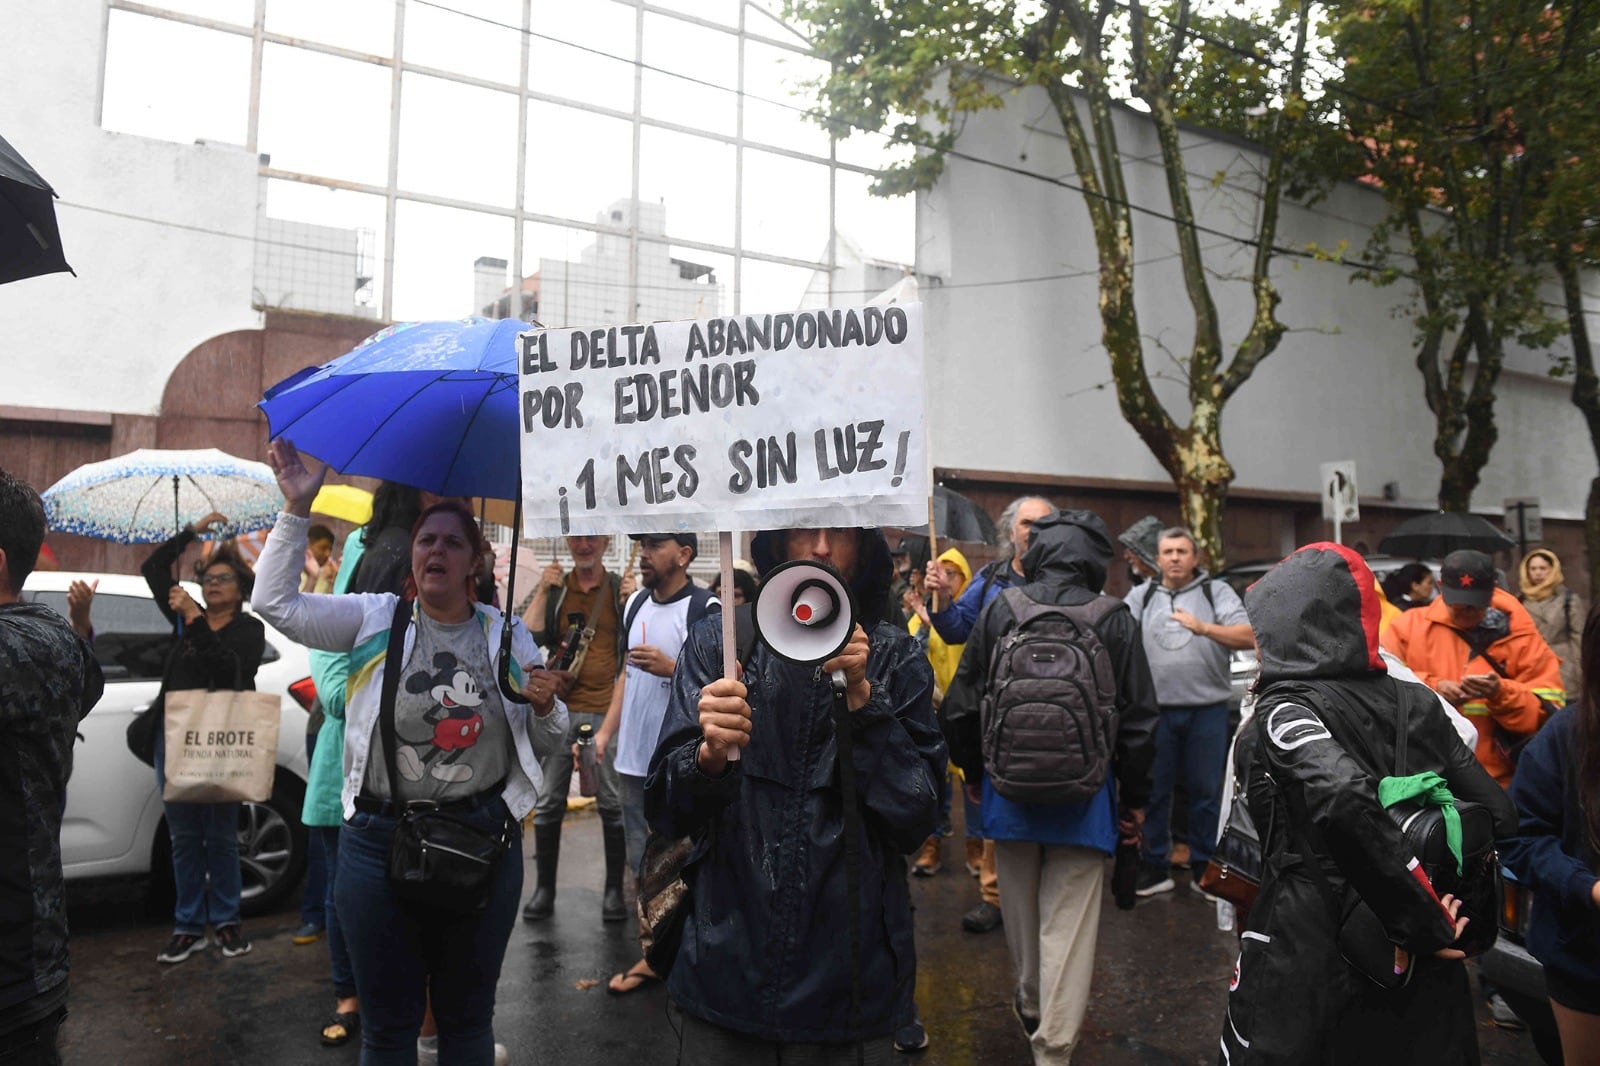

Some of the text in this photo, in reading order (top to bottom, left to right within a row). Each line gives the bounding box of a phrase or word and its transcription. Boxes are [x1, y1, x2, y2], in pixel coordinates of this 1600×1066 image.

[521, 306, 908, 375] EL DELTA ABANDONADO
[523, 359, 760, 433] POR EDENOR
[616, 444, 699, 506] MES
[728, 431, 798, 494] SIN
[183, 748, 255, 760] TIENDA NATURAL
[184, 730, 255, 747] EL BROTE
